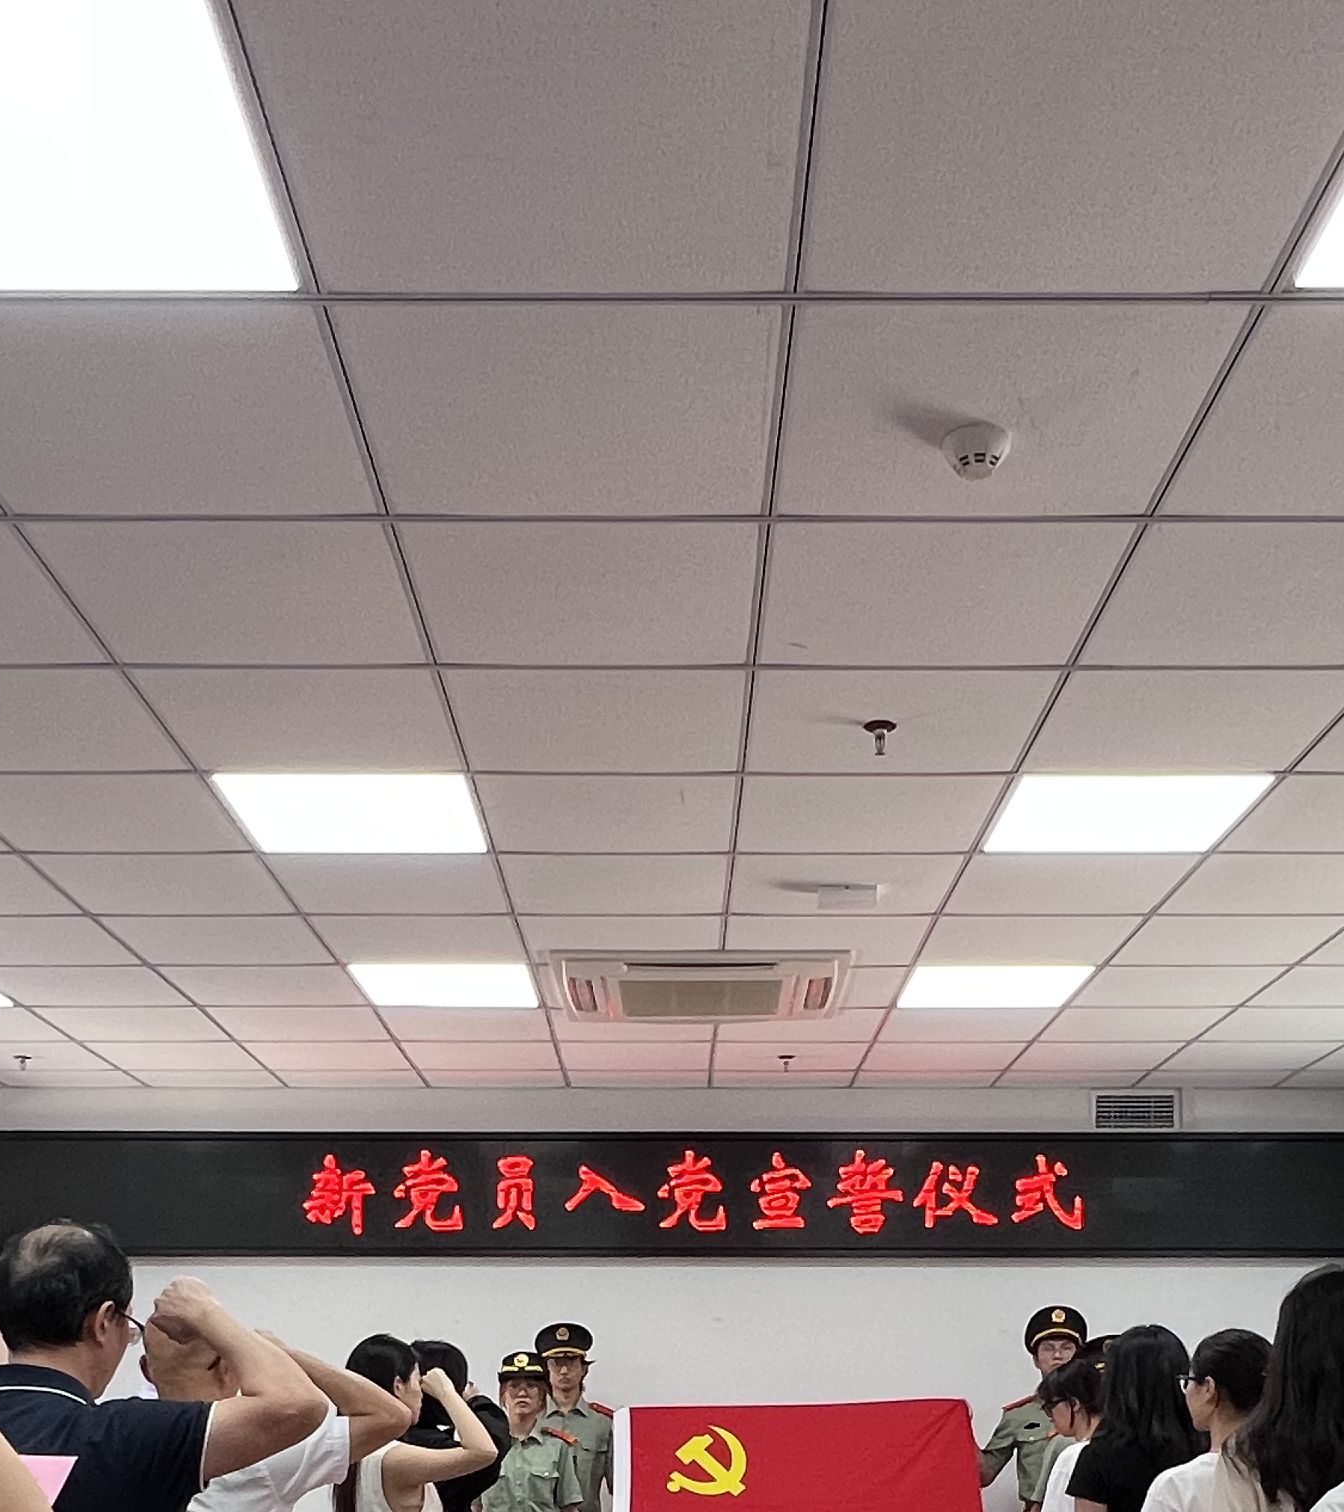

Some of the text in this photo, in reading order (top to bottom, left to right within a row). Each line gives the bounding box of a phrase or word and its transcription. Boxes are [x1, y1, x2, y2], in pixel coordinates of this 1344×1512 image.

[302, 1150, 1084, 1235] 新党员入党宣誓仪式
